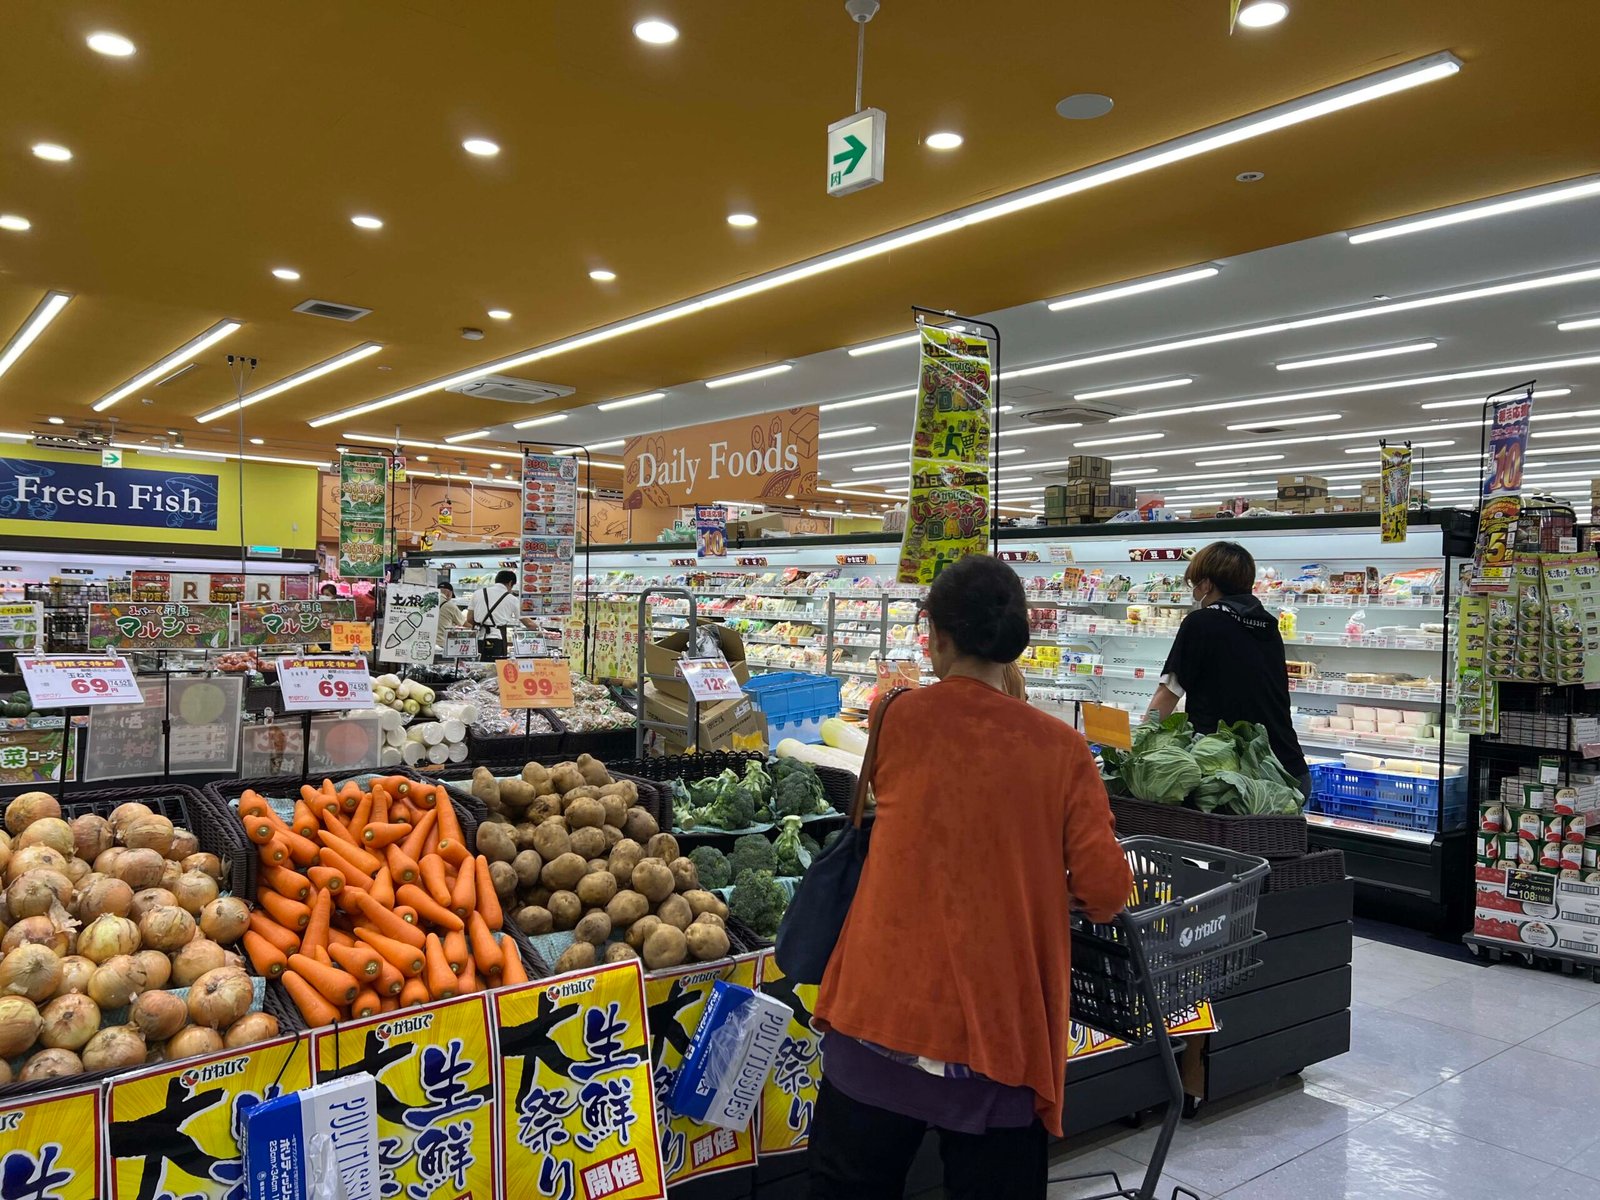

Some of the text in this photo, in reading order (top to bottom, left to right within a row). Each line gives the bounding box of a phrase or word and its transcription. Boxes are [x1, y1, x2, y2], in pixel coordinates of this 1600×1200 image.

[937, 388, 982, 412] DAY
[636, 432, 800, 493] Daily Foods
[14, 475, 203, 515] Fresh Fish
[911, 496, 987, 524] いっちゃう
[926, 516, 975, 541] DAY
[183, 581, 199, 599] R
[257, 583, 272, 600] R
[115, 615, 202, 639] マルシェ
[261, 613, 331, 635] マルシェ
[71, 678, 109, 694] 69
[318, 681, 349, 697] 69
[523, 678, 553, 696] 99
[0, 747, 27, 768] 菜
[29, 750, 63, 761] コーナー
[1519, 889, 1536, 901] 108
[1194, 915, 1227, 941] かねひで
[560, 978, 595, 997] かねひで
[393, 1012, 434, 1035] かねひで
[200, 1056, 250, 1082] かねひで
[568, 1002, 642, 1152] 生鮮
[584, 1157, 641, 1200] 開催
